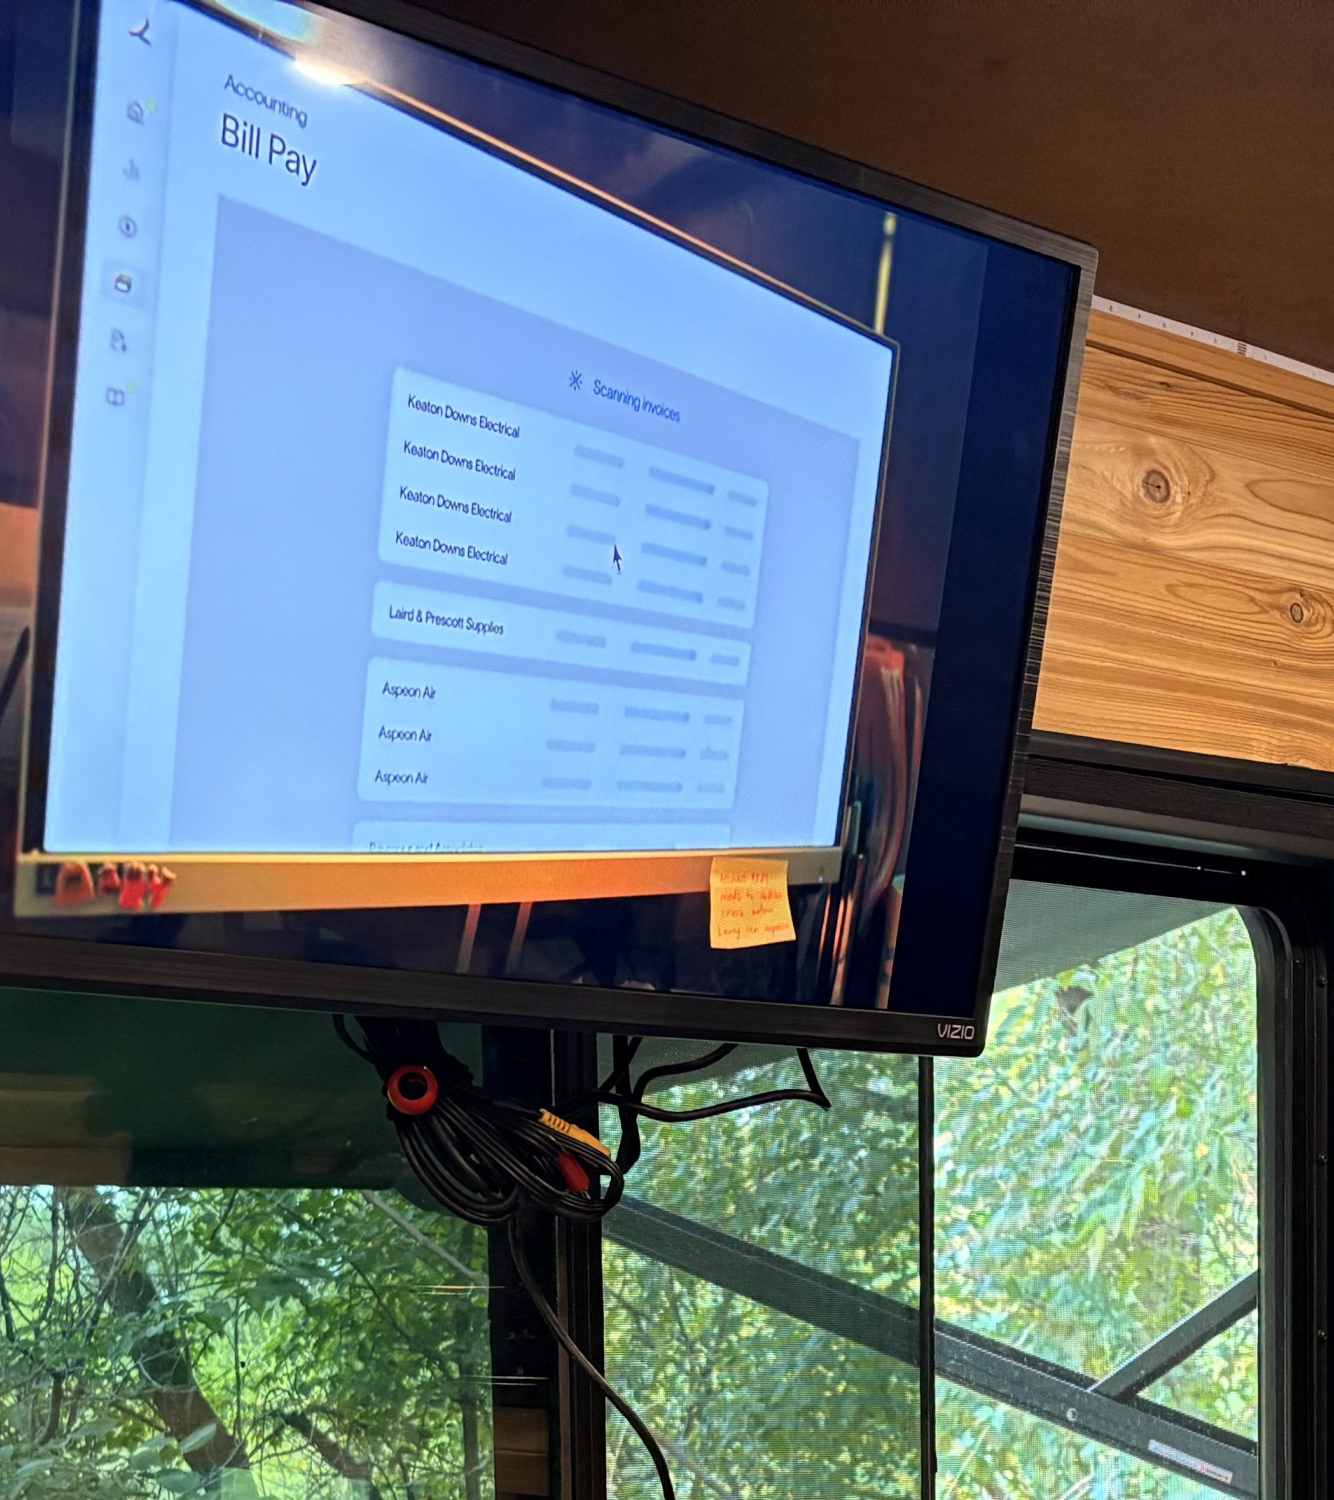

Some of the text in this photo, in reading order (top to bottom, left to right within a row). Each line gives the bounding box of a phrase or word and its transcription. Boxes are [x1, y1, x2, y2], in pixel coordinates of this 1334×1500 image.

[224, 74, 308, 129] Accounting
[221, 112, 317, 187] Bill Pay
[408, 395, 520, 438] Keaton Downs Electrical
[593, 379, 681, 423] Scanning invoices
[404, 440, 516, 481] Keaton Downs Electrical
[399, 486, 512, 523] Keaton Downs Electrical
[396, 531, 508, 566] Keaton Downs Electrical
[389, 604, 504, 635] Laird & Prescott Supplies
[423, 686, 436, 699] Air
[419, 729, 432, 742] Air
[415, 772, 428, 784] Air
[937, 1023, 975, 1040] VIZIO
